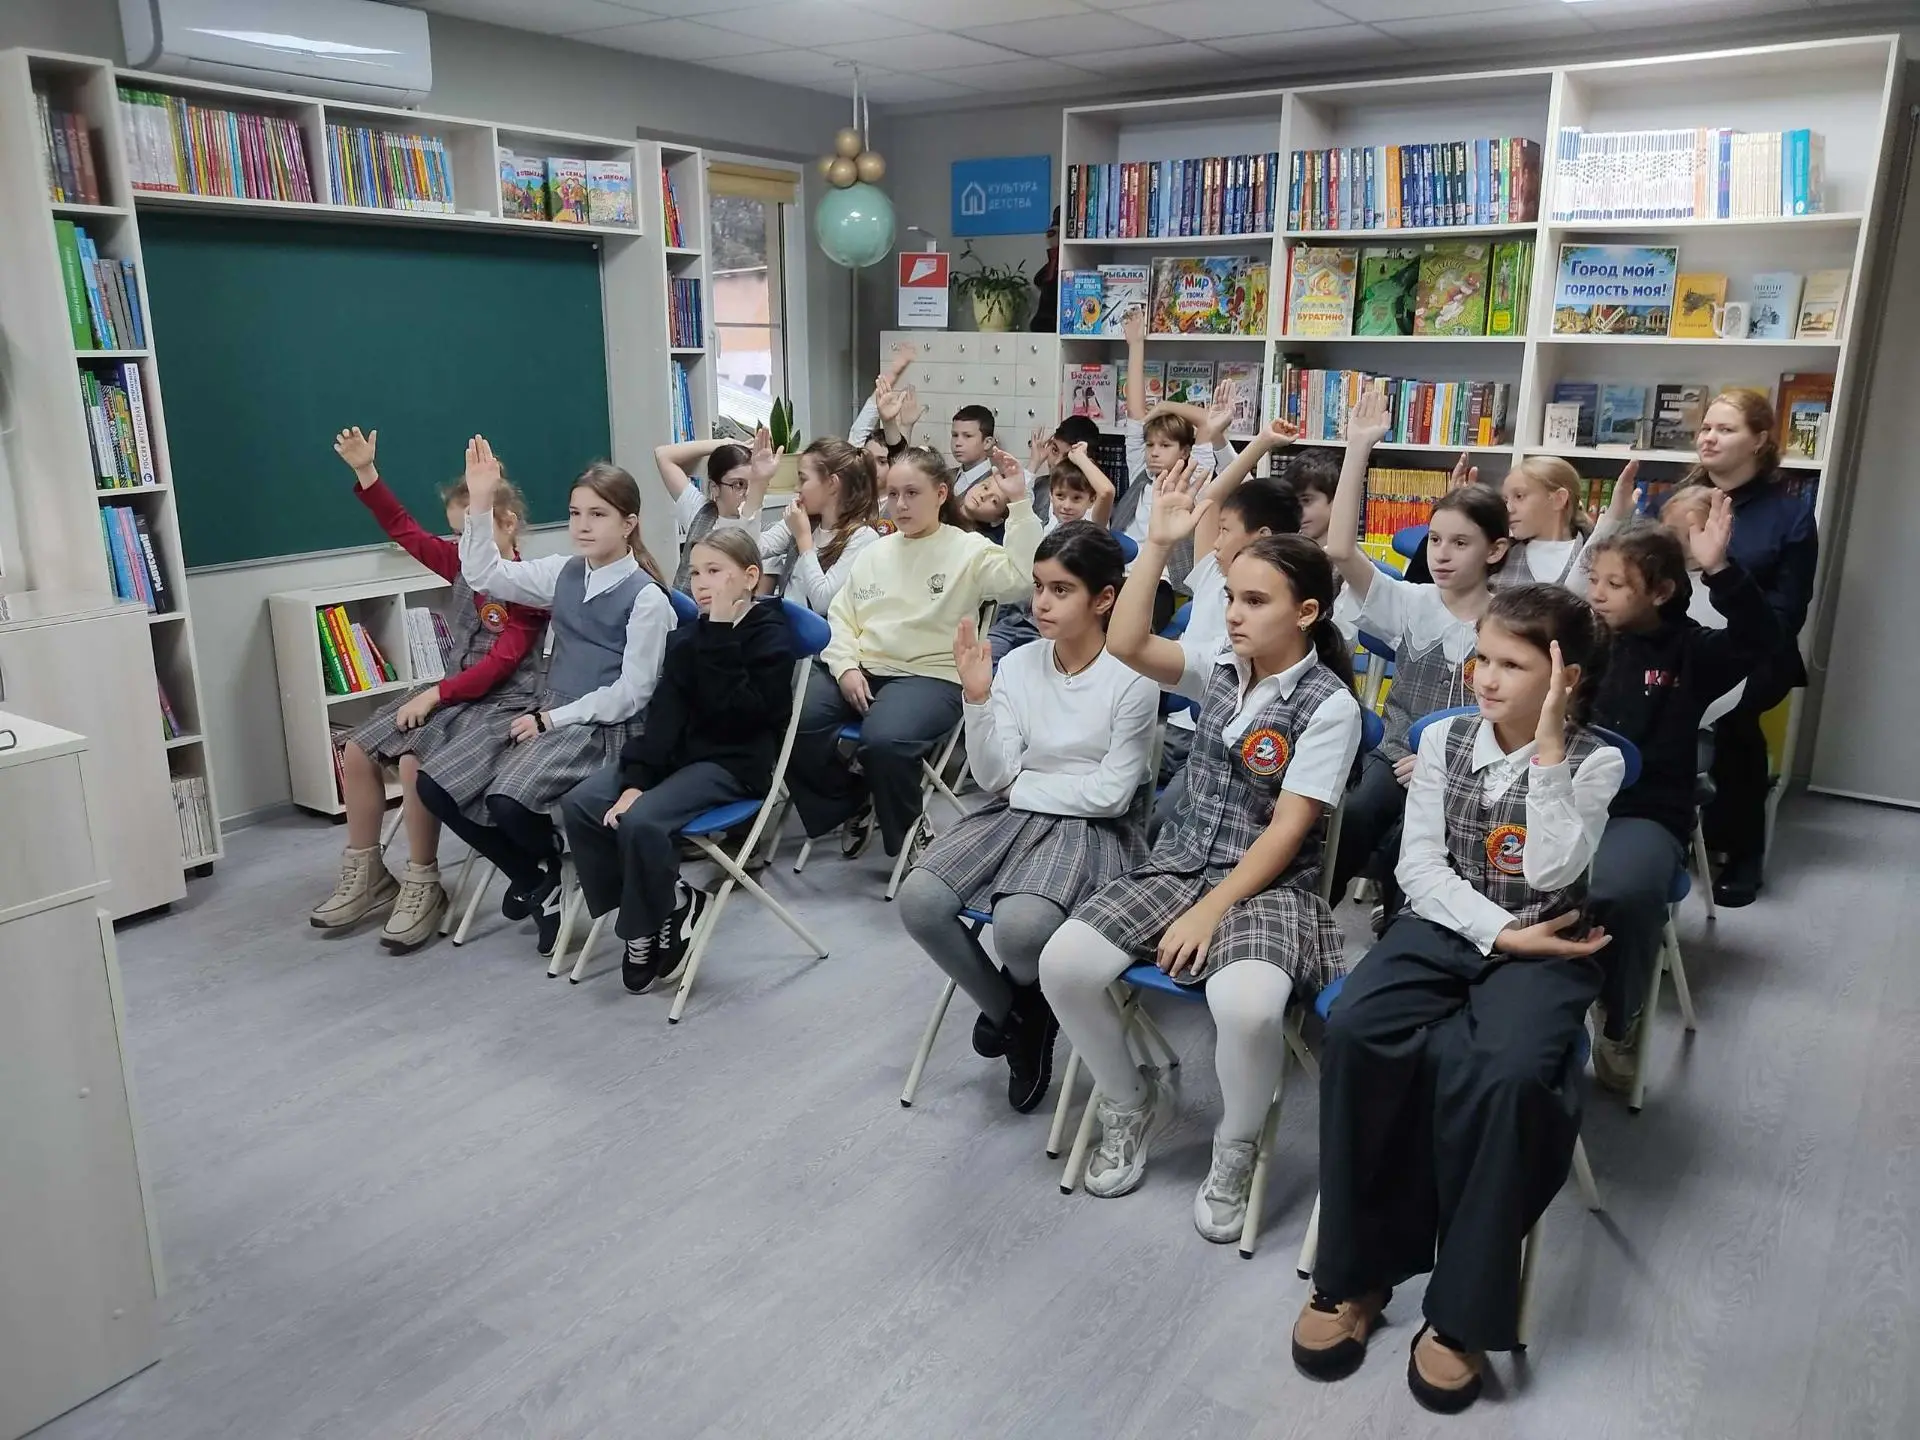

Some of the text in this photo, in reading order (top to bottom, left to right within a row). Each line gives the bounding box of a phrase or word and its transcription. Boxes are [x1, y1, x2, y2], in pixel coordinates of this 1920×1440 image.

[988, 181, 1038, 194] КУЛЬТУРА
[988, 197, 1032, 212] ДЕТСТВА
[1103, 271, 1144, 279] РЫБАЛКА
[1184, 275, 1209, 290] Мир
[1296, 312, 1345, 321] БУРАТИНО
[1172, 366, 1209, 374] ОРИГАМИ
[139, 533, 164, 592] ДИНОЗАВРЫ
